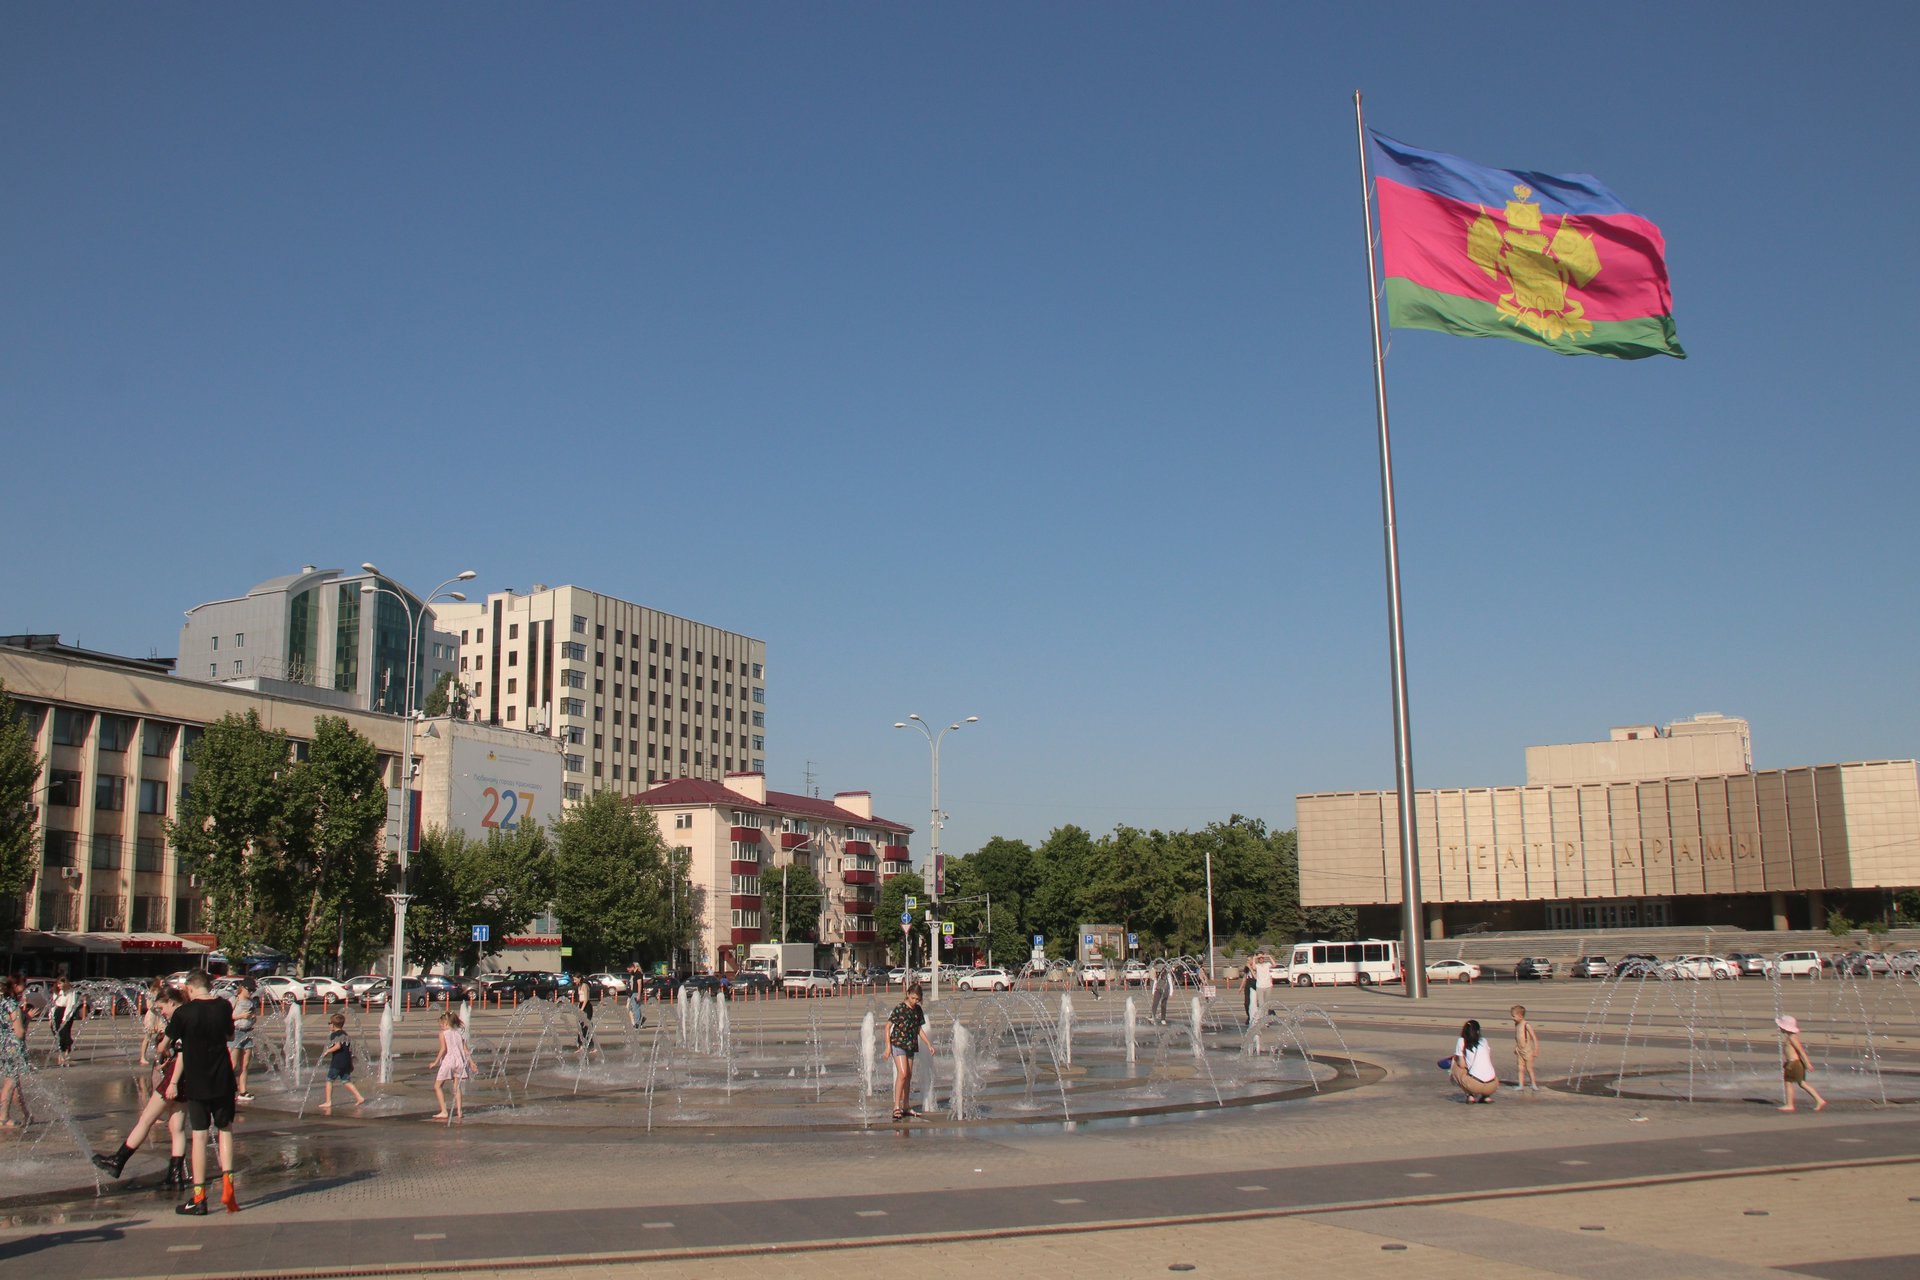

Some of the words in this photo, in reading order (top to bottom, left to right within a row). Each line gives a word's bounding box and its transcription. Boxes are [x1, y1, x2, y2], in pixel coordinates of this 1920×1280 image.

[481, 787, 535, 830] 227
[1449, 841, 1575, 870] ТЕАТР
[1619, 832, 1755, 868] ДРАМЫ
